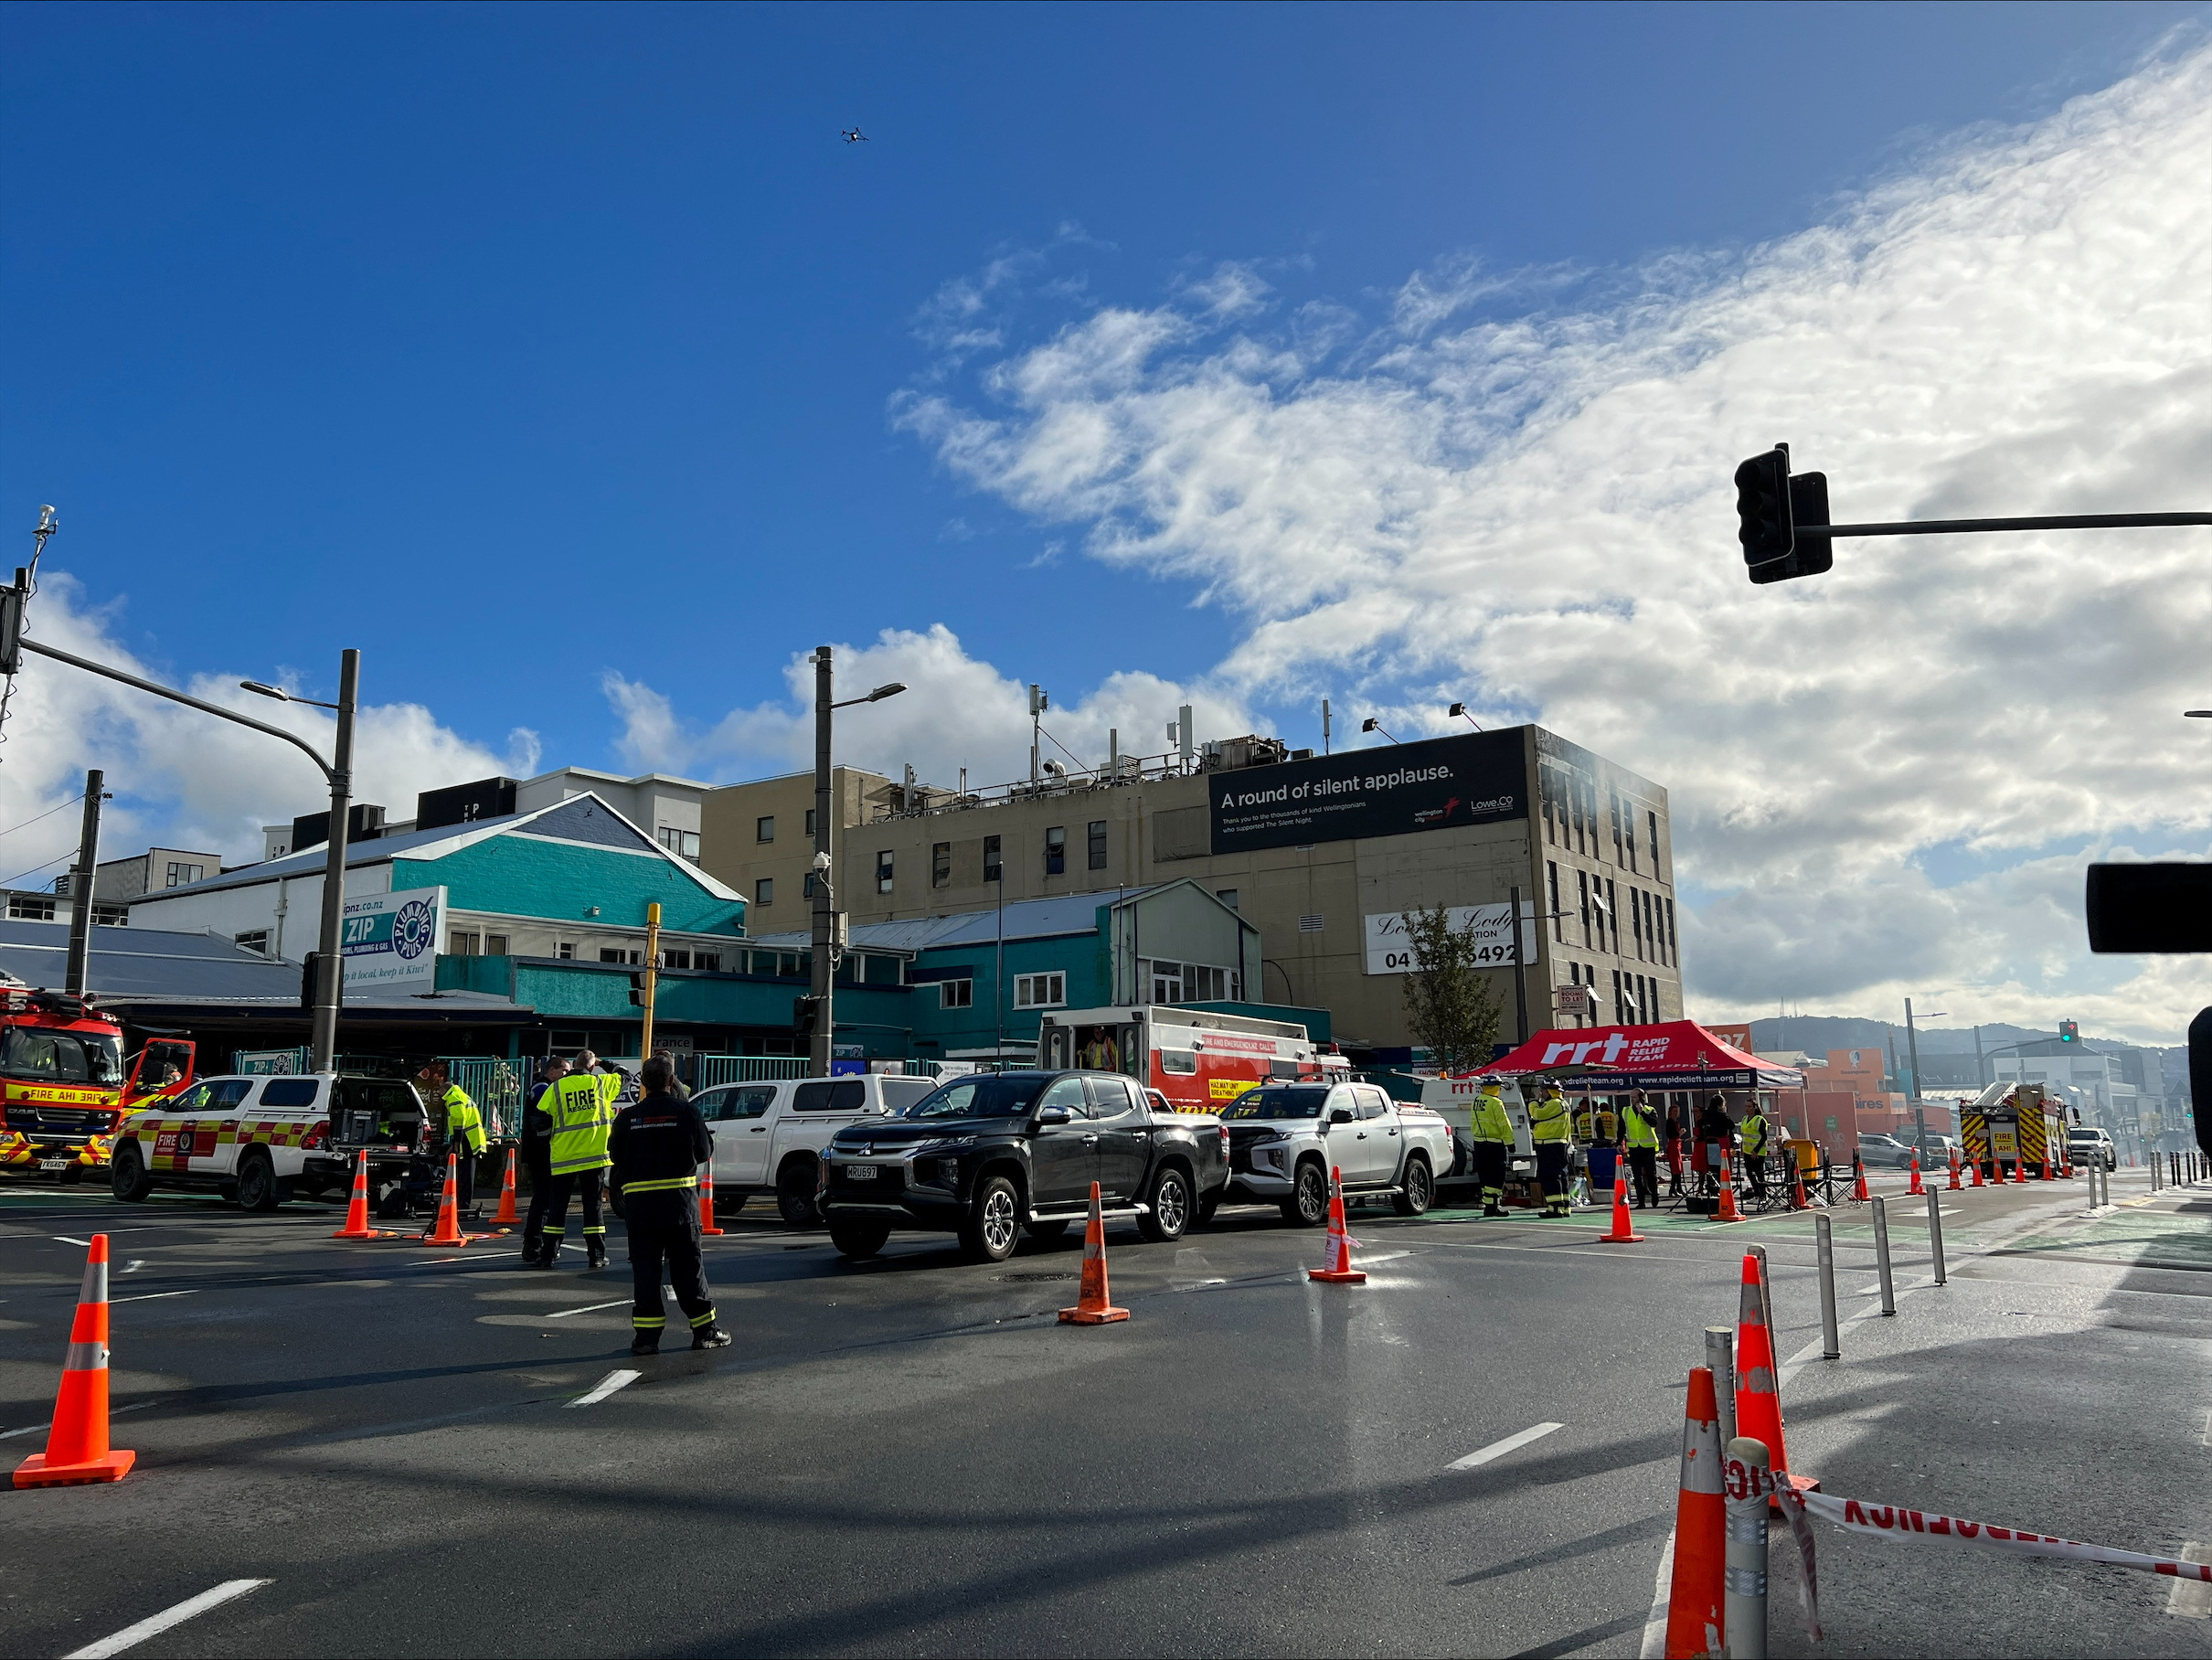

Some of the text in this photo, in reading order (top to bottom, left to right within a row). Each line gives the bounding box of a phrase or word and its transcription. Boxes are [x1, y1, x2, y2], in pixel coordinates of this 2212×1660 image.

[1221, 765, 1454, 809] A round of silent applause.
[1270, 809, 1301, 819] thousands
[1323, 801, 1367, 813] Wellingtonians
[1414, 808, 1443, 817] wellington
[1236, 822, 1265, 832] supported
[1277, 818, 1294, 827] Silent
[343, 900, 384, 916] ipnz.co.nz
[394, 901, 431, 937] PLUMBING
[1460, 908, 1514, 931] Lodg
[346, 917, 375, 942] ZIP
[400, 940, 421, 958] PLUS
[1385, 952, 1410, 969] 04
[378, 968, 397, 979] keep
[399, 966, 406, 976] it
[1540, 1032, 1630, 1065] rrt
[1632, 1037, 1671, 1048] RAPID
[1629, 1046, 1670, 1056] RELIEF
[1627, 1053, 1664, 1063] TEAM
[252, 1060, 266, 1073] ZIP
[1452, 1081, 1474, 1094] rrt
[30, 1090, 76, 1101] FIRE AHI
[565, 1089, 596, 1108] FIRE
[568, 1103, 597, 1113] RESCUE
[1856, 1097, 1884, 1109] aires
[158, 1134, 177, 1146] FIRE
